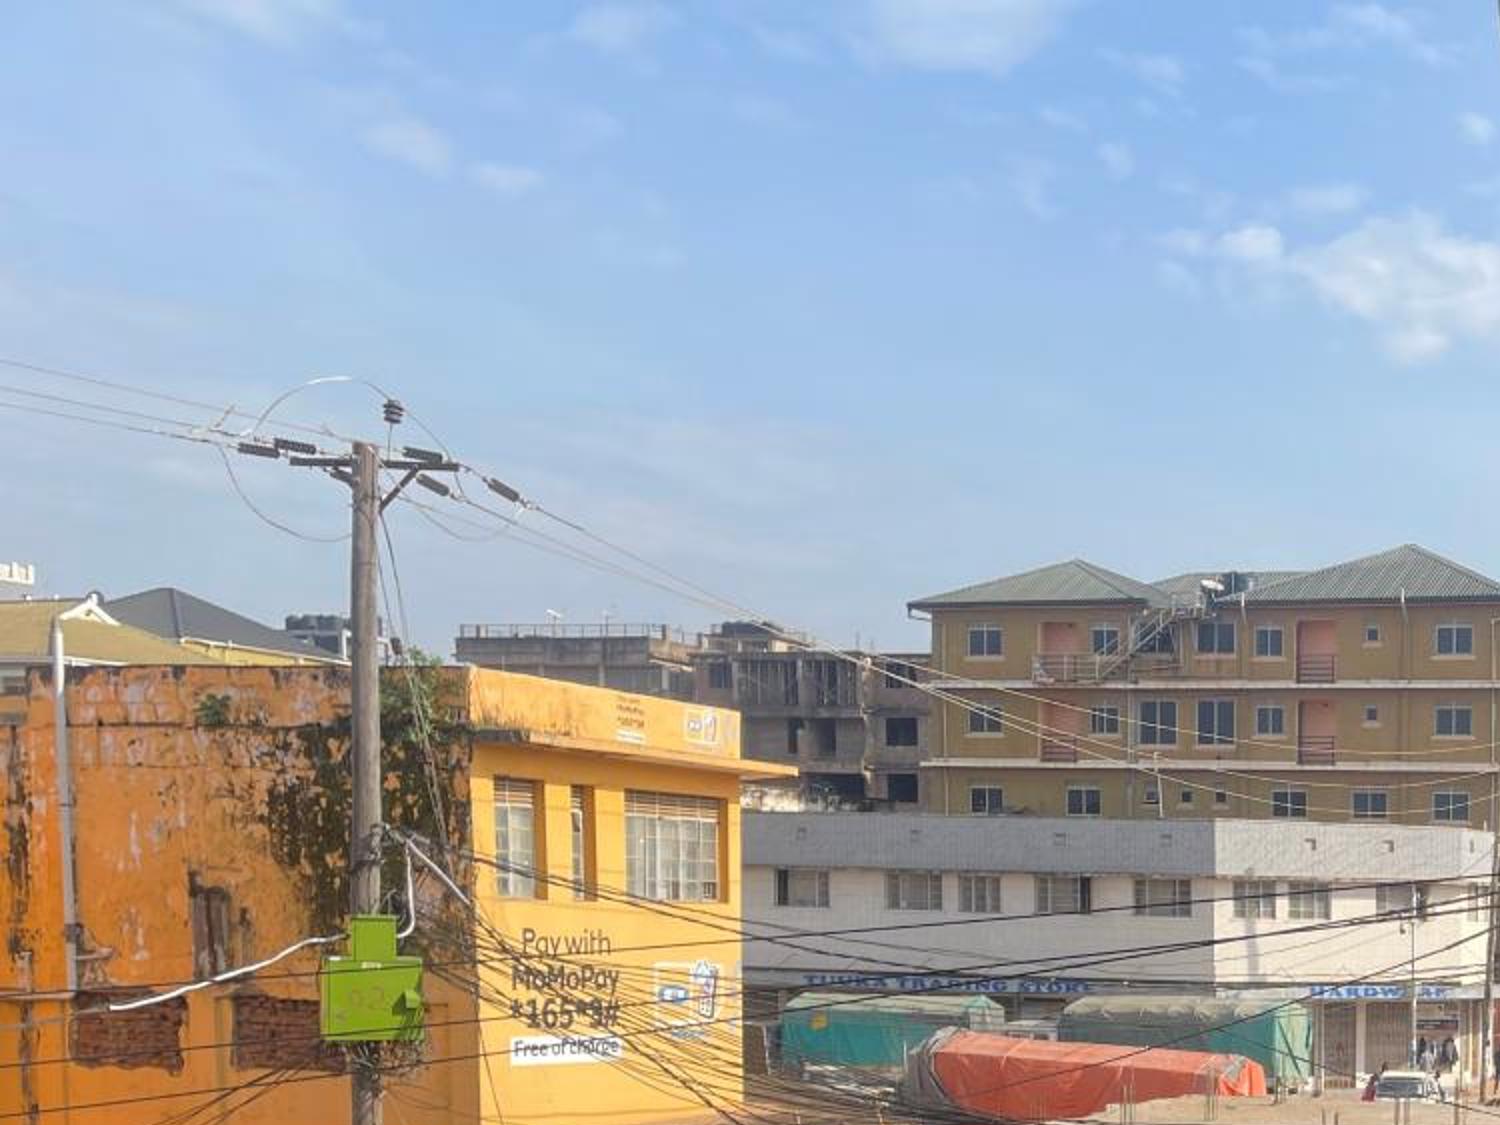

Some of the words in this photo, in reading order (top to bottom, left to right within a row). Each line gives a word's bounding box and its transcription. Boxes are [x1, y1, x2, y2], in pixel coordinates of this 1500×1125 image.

[522, 928, 560, 957] Pay
[565, 928, 612, 955] with
[511, 963, 620, 994] MoMoPay
[1311, 983, 1447, 998] HARDWRE
[513, 1040, 549, 1057] Free
[551, 1037, 568, 1055] of
[569, 1036, 620, 1057] charge
